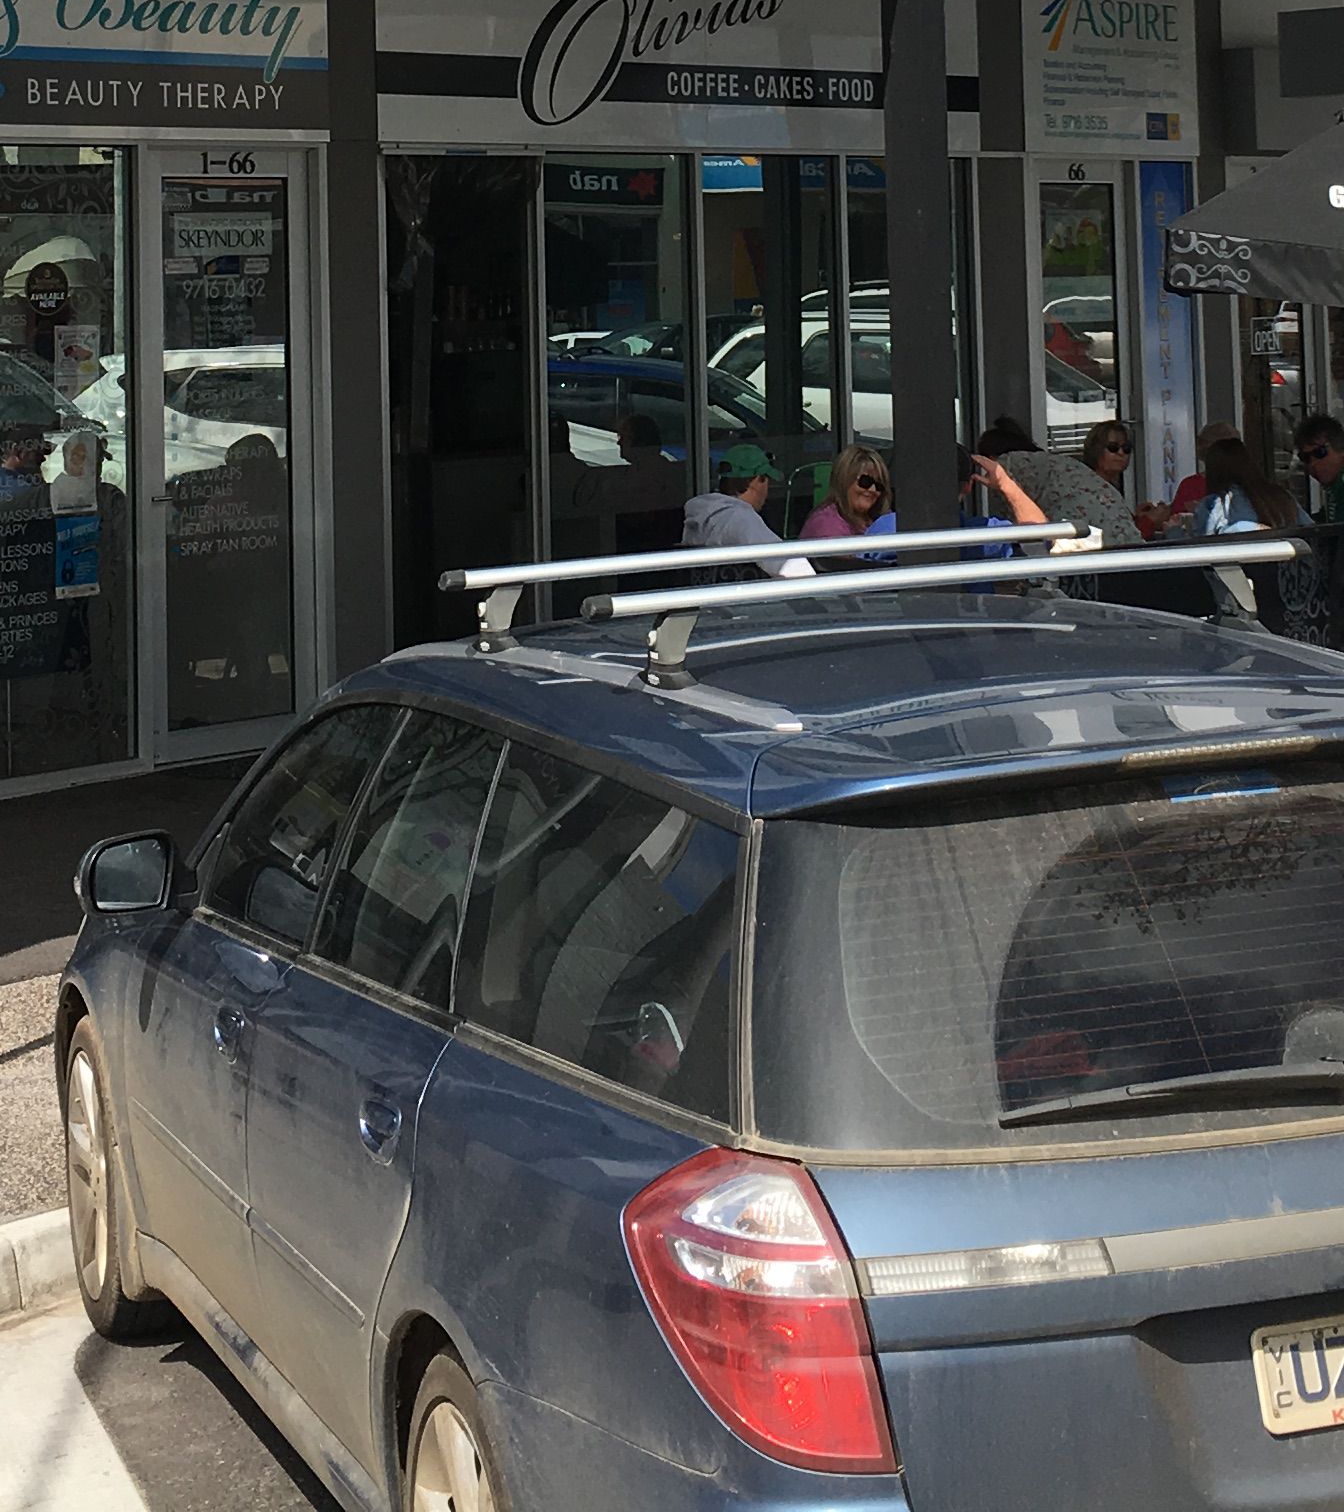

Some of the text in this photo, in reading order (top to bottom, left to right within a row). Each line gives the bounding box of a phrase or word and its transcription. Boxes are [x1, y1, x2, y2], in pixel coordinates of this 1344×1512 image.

[27, 80, 143, 108] BEAUTY
[160, 82, 283, 111] THERAPY
[668, 71, 874, 102] COFFEE CAKES FOOD
[1068, 164, 1086, 181] 66
[178, 229, 265, 248] SKEYNDOR
[183, 278, 266, 299] 9716 0432
[180, 502, 249, 519] ALTERNATIVE
[222, 515, 280, 531] PRODUCTS
[1, 542, 54, 557] LESSONS
[180, 535, 278, 556] SPRAY TAN ROOM
